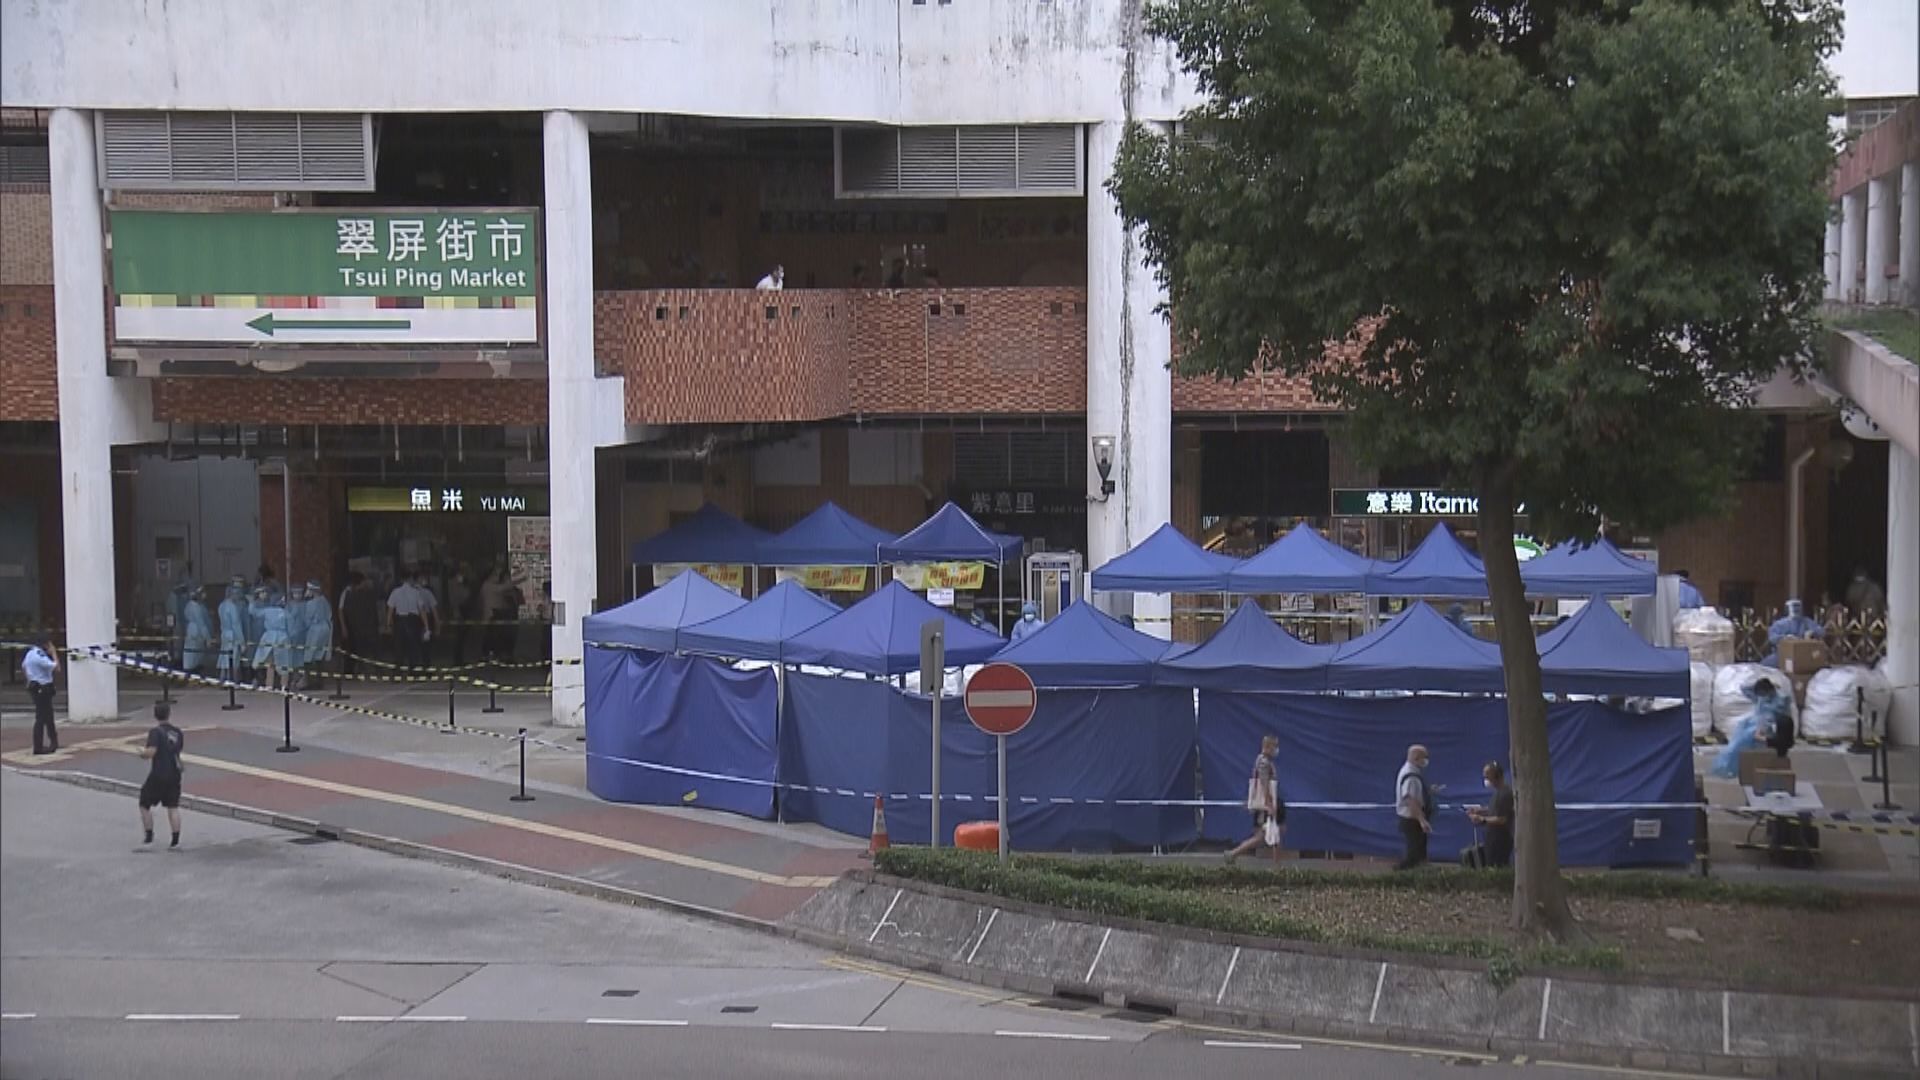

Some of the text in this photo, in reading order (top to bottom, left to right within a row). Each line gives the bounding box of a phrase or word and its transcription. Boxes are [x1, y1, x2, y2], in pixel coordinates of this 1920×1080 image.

[336, 218, 526, 262] 翠屏街市
[339, 267, 526, 290] Tsui Ping Market
[411, 488, 463, 511] 魚米
[480, 497, 526, 511] YU MAI
[1366, 491, 1412, 514] 意樂
